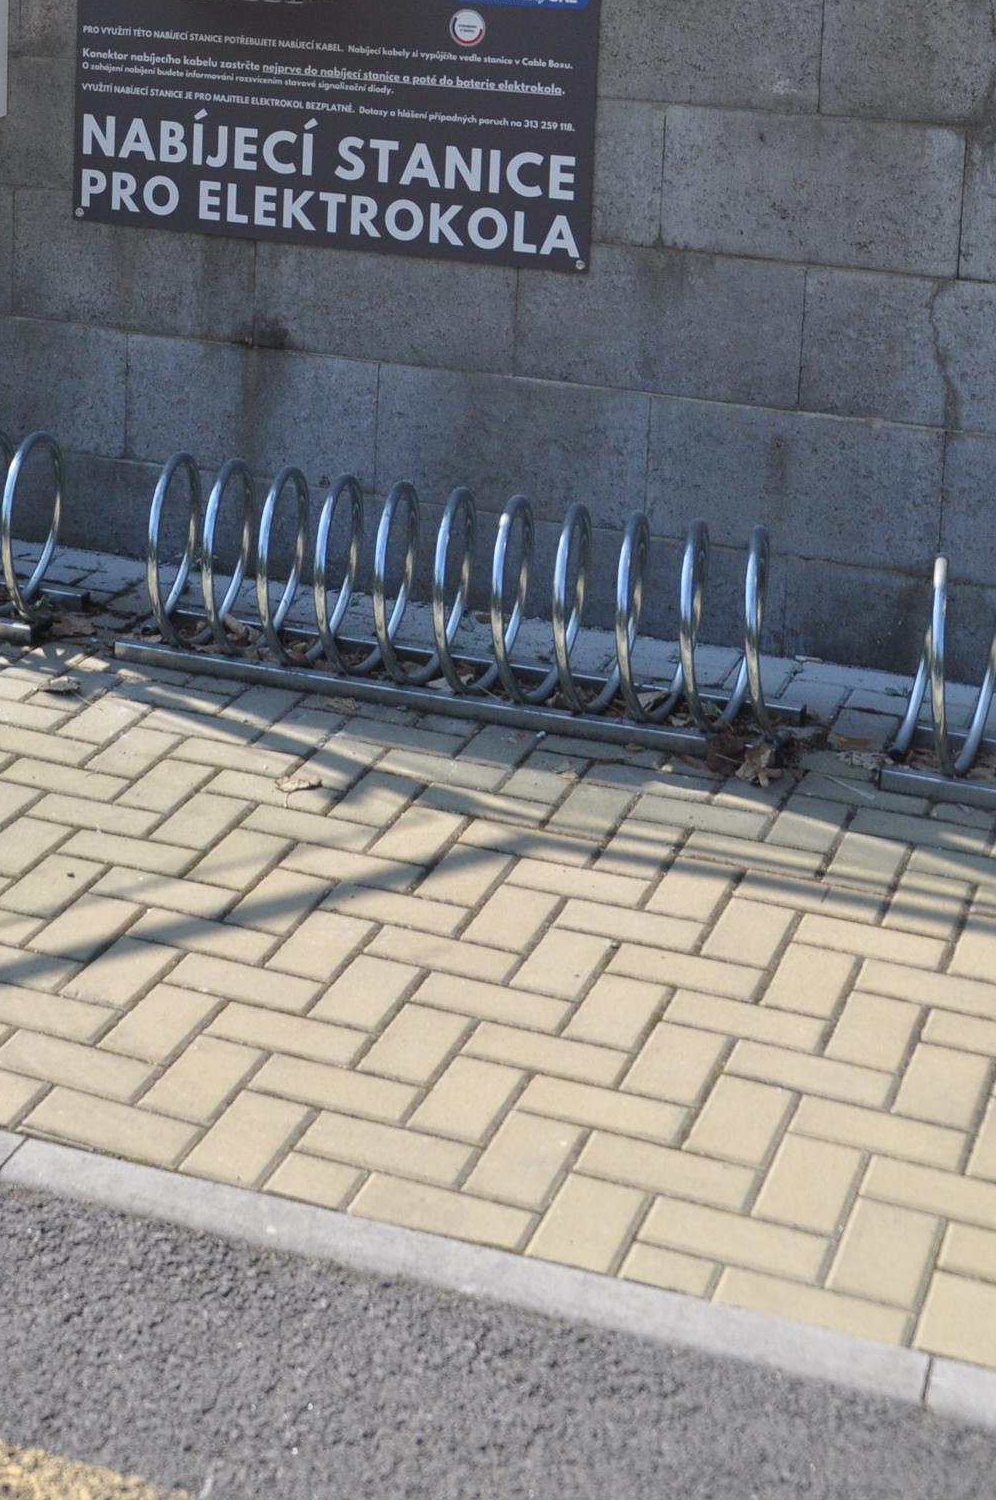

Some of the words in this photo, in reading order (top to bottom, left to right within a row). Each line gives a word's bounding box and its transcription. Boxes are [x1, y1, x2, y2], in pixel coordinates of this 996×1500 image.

[83, 25, 100, 34] PRO
[101, 26, 132, 37] VYUŽITÍ
[133, 27, 152, 38] TÉTO
[154, 29, 188, 41] NABÍJECÍ
[189, 33, 223, 44] STANICE
[224, 34, 277, 48] POTŘEBUJETE
[278, 39, 315, 50] NABÍJECÍ
[315, 42, 344, 52] KABEL.
[348, 44, 381, 57] Nabíjecí
[382, 46, 410, 59] kabely
[412, 49, 419, 57] si
[459, 53, 482, 63] vedle
[483, 55, 513, 65] stanice
[522, 57, 547, 68] Cable
[548, 59, 573, 69] Boxu.
[82, 48, 128, 61] Konektor
[130, 52, 181, 66] nabíjecího
[183, 54, 218, 67] kabelu
[220, 59, 260, 71] zastrčte
[263, 62, 302, 75] nejprve
[304, 64, 318, 75] do
[320, 66, 361, 80] nabíjecí
[363, 71, 400, 81] stanice
[412, 74, 437, 85] poté
[439, 75, 454, 86] do
[456, 77, 496, 89] baterie
[498, 80, 565, 95] elektrokola.
[82, 61, 89, 69] O
[90, 62, 123, 73] zahájení
[124, 64, 156, 75] nabíjení
[157, 68, 184, 77] budete
[367, 84, 395, 95] diody.
[82, 82, 113, 92] VYUŽITÍ
[114, 85, 149, 96] NABÍJECÍ
[150, 88, 183, 99] STANICE
[184, 91, 193, 100] JE
[194, 92, 211, 101] PRO
[213, 93, 250, 104] MAJITELE
[251, 97, 304, 109] ELEKTROKOL
[359, 105, 388, 117] Dotazy
[397, 108, 427, 119] hlášení
[428, 111, 477, 125] případných
[478, 116, 509, 127] poruch
[524, 120, 539, 129] 313
[541, 121, 558, 130] 259
[560, 122, 575, 132] 118.
[81, 107, 315, 177] NABÍJECÍ
[334, 135, 577, 201] STANICE
[80, 169, 180, 217] PRO
[197, 180, 580, 259] ELEKTROKOLA
